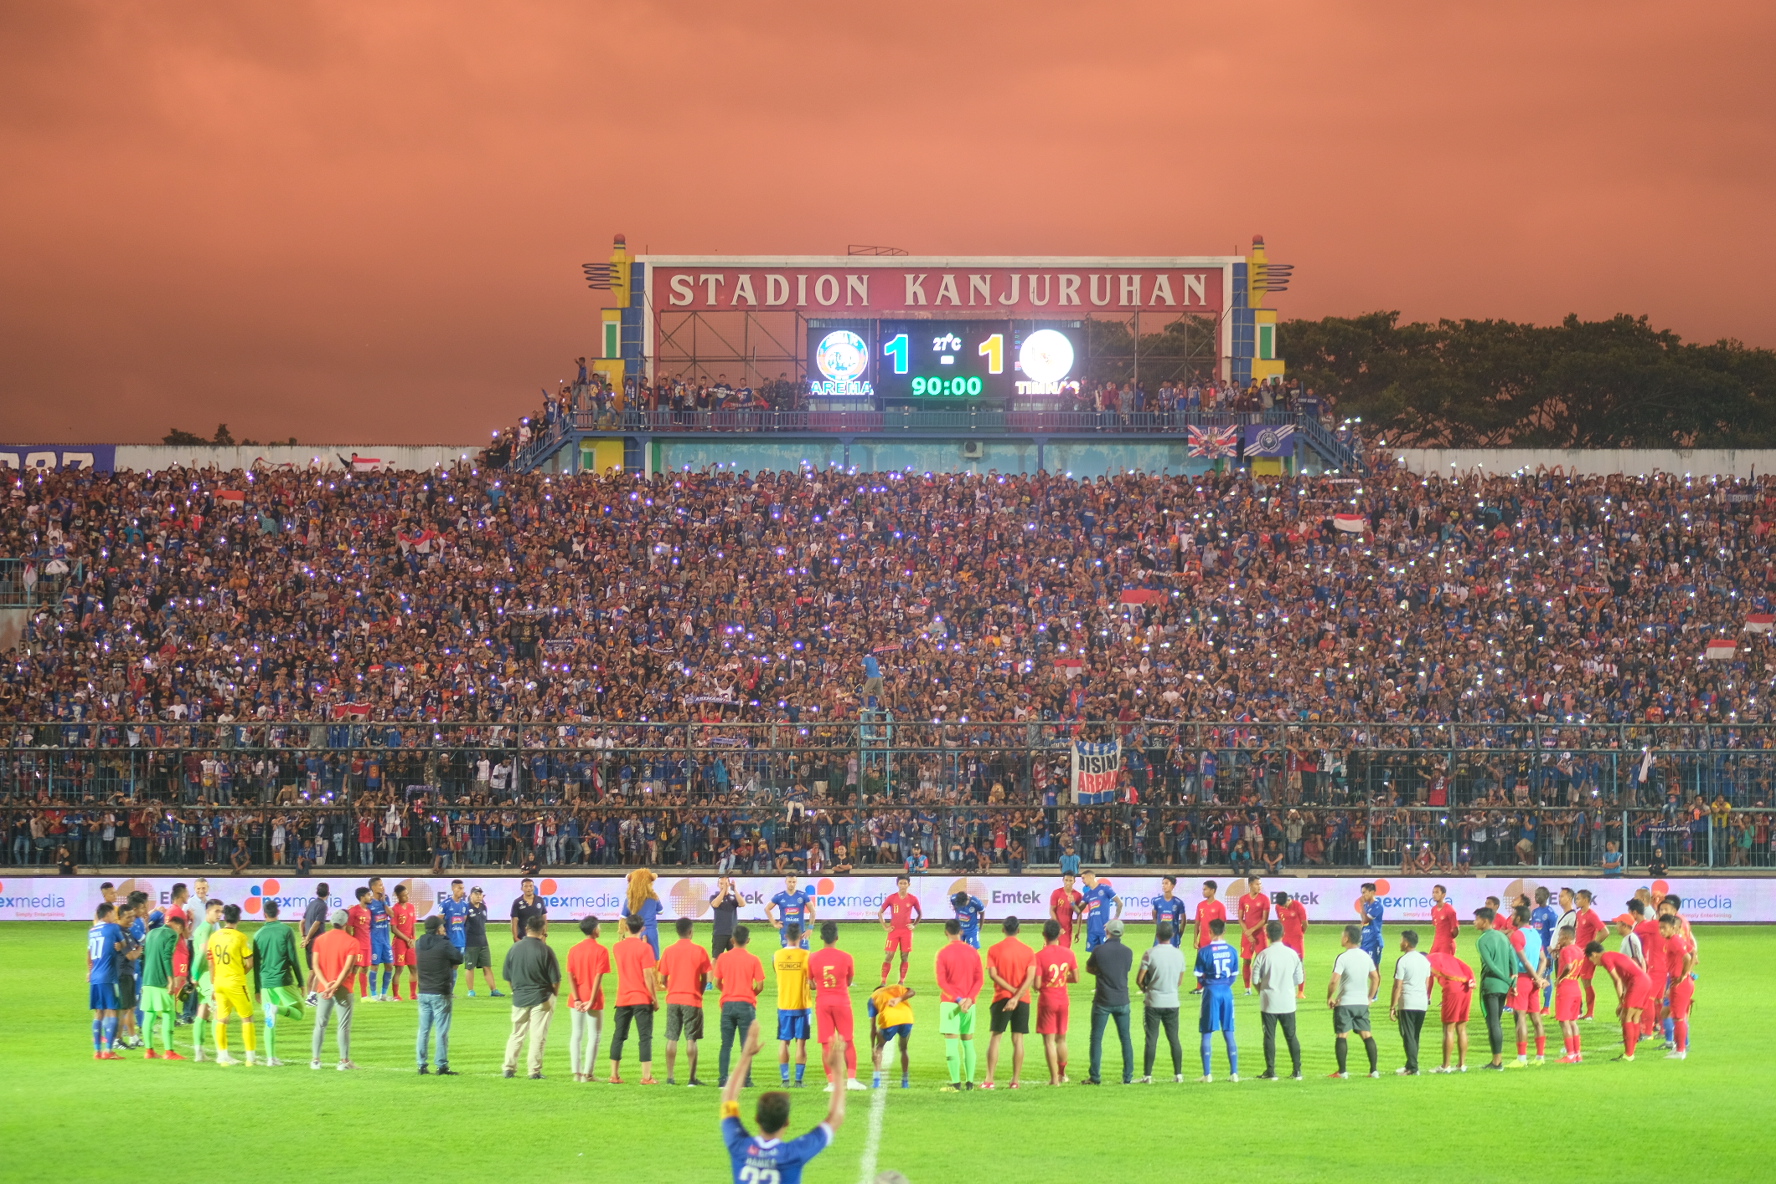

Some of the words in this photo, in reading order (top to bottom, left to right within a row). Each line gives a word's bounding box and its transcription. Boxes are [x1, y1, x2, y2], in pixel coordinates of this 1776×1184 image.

[669, 274, 870, 306] STADION
[904, 274, 1207, 306] KANJURUHAN
[884, 333, 908, 374] 1
[979, 333, 1003, 374] 1
[811, 381, 874, 395] AREMA
[911, 376, 983, 396] 90:00
[1076, 741, 1118, 755] KITA
[1078, 770, 1118, 793] AREMA
[262, 894, 342, 907] nexmia
[992, 890, 1041, 904] Emtek
[1270, 891, 1319, 905] Etek
[214, 945, 231, 965] 96
[822, 966, 837, 988] 5
[1046, 962, 1068, 988] 23
[1213, 958, 1231, 979] 15
